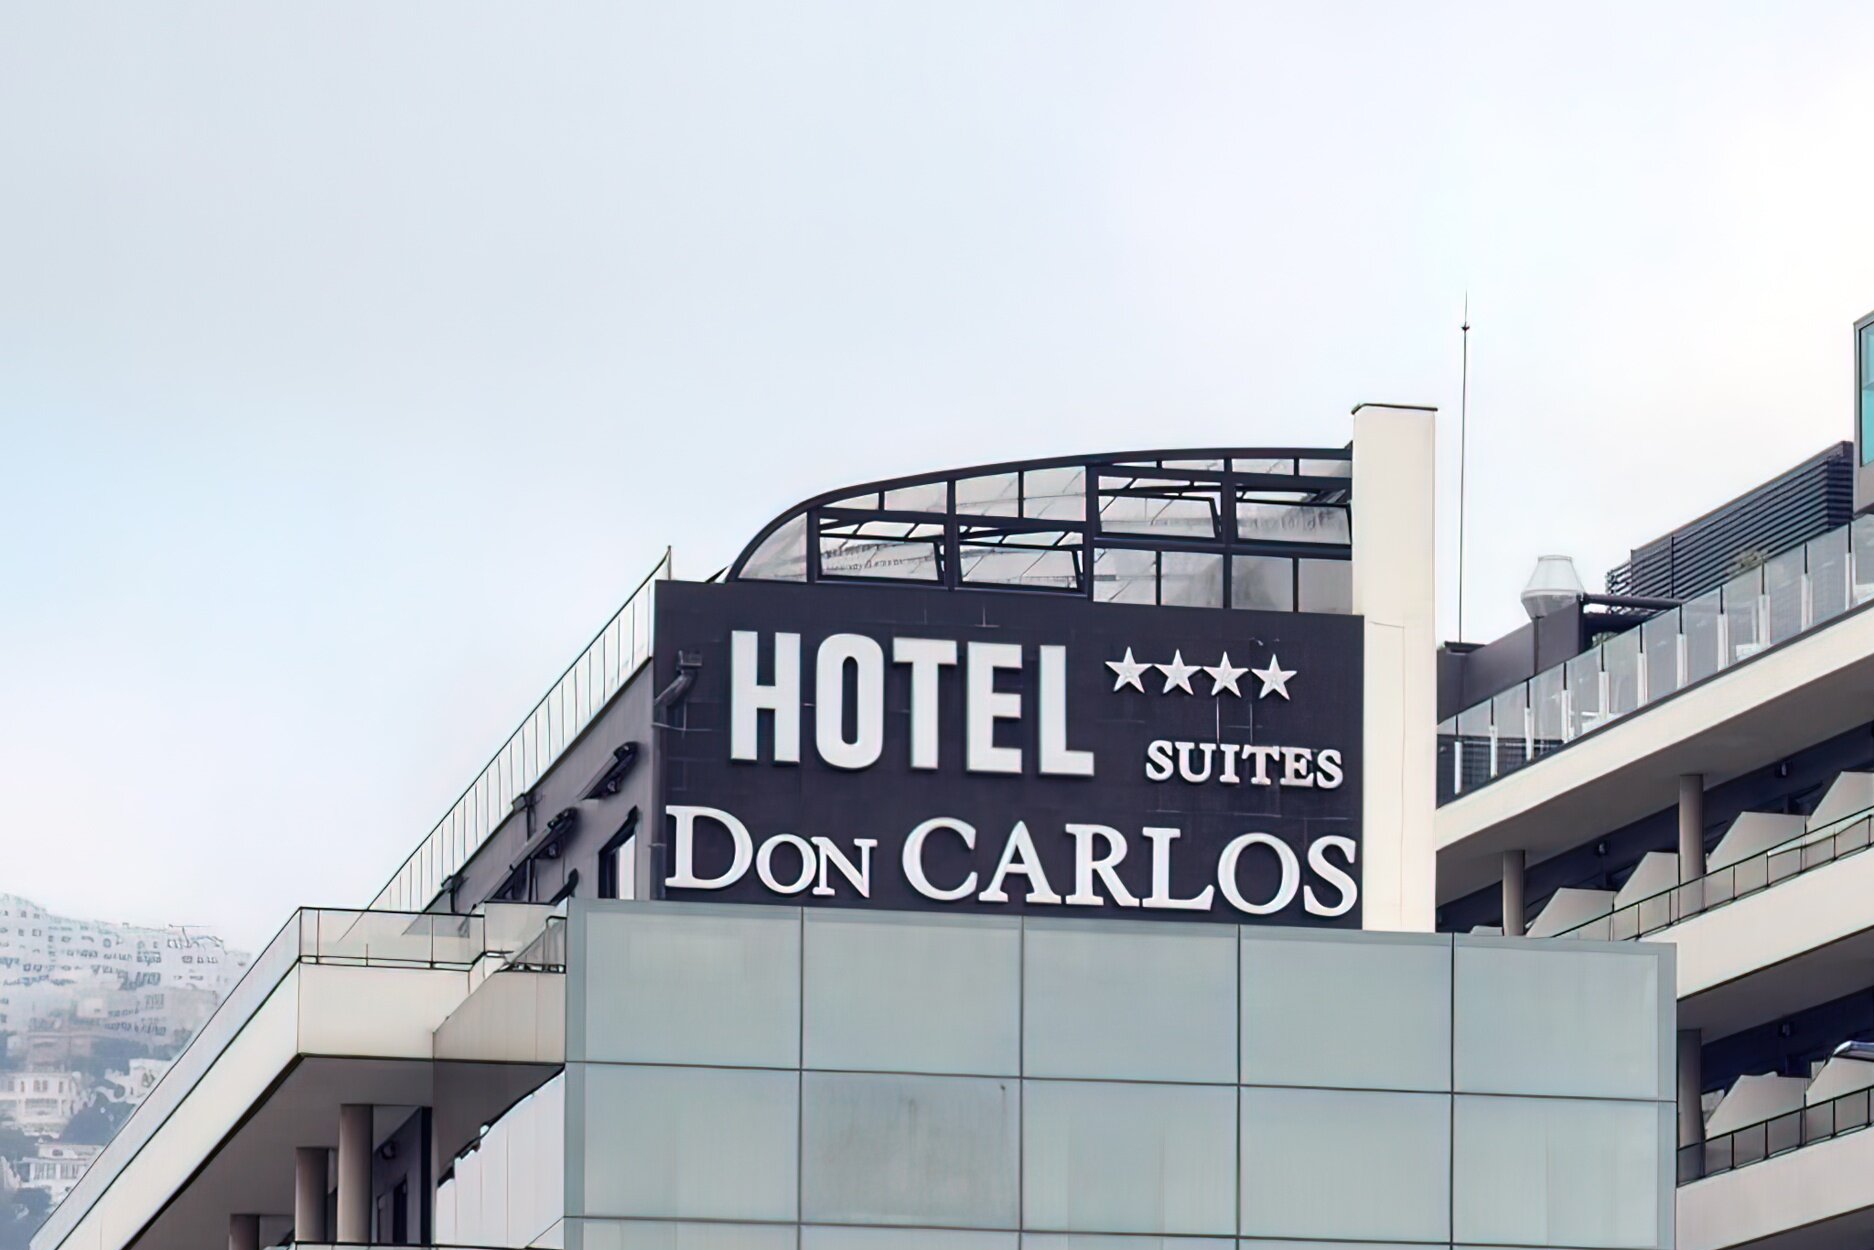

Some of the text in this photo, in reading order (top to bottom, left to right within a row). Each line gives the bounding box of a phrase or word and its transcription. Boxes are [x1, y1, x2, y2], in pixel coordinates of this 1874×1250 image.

[730, 630, 1096, 777] HOTEL
[1145, 739, 1343, 790] SUITES
[665, 805, 1359, 918] DON CARLOS
